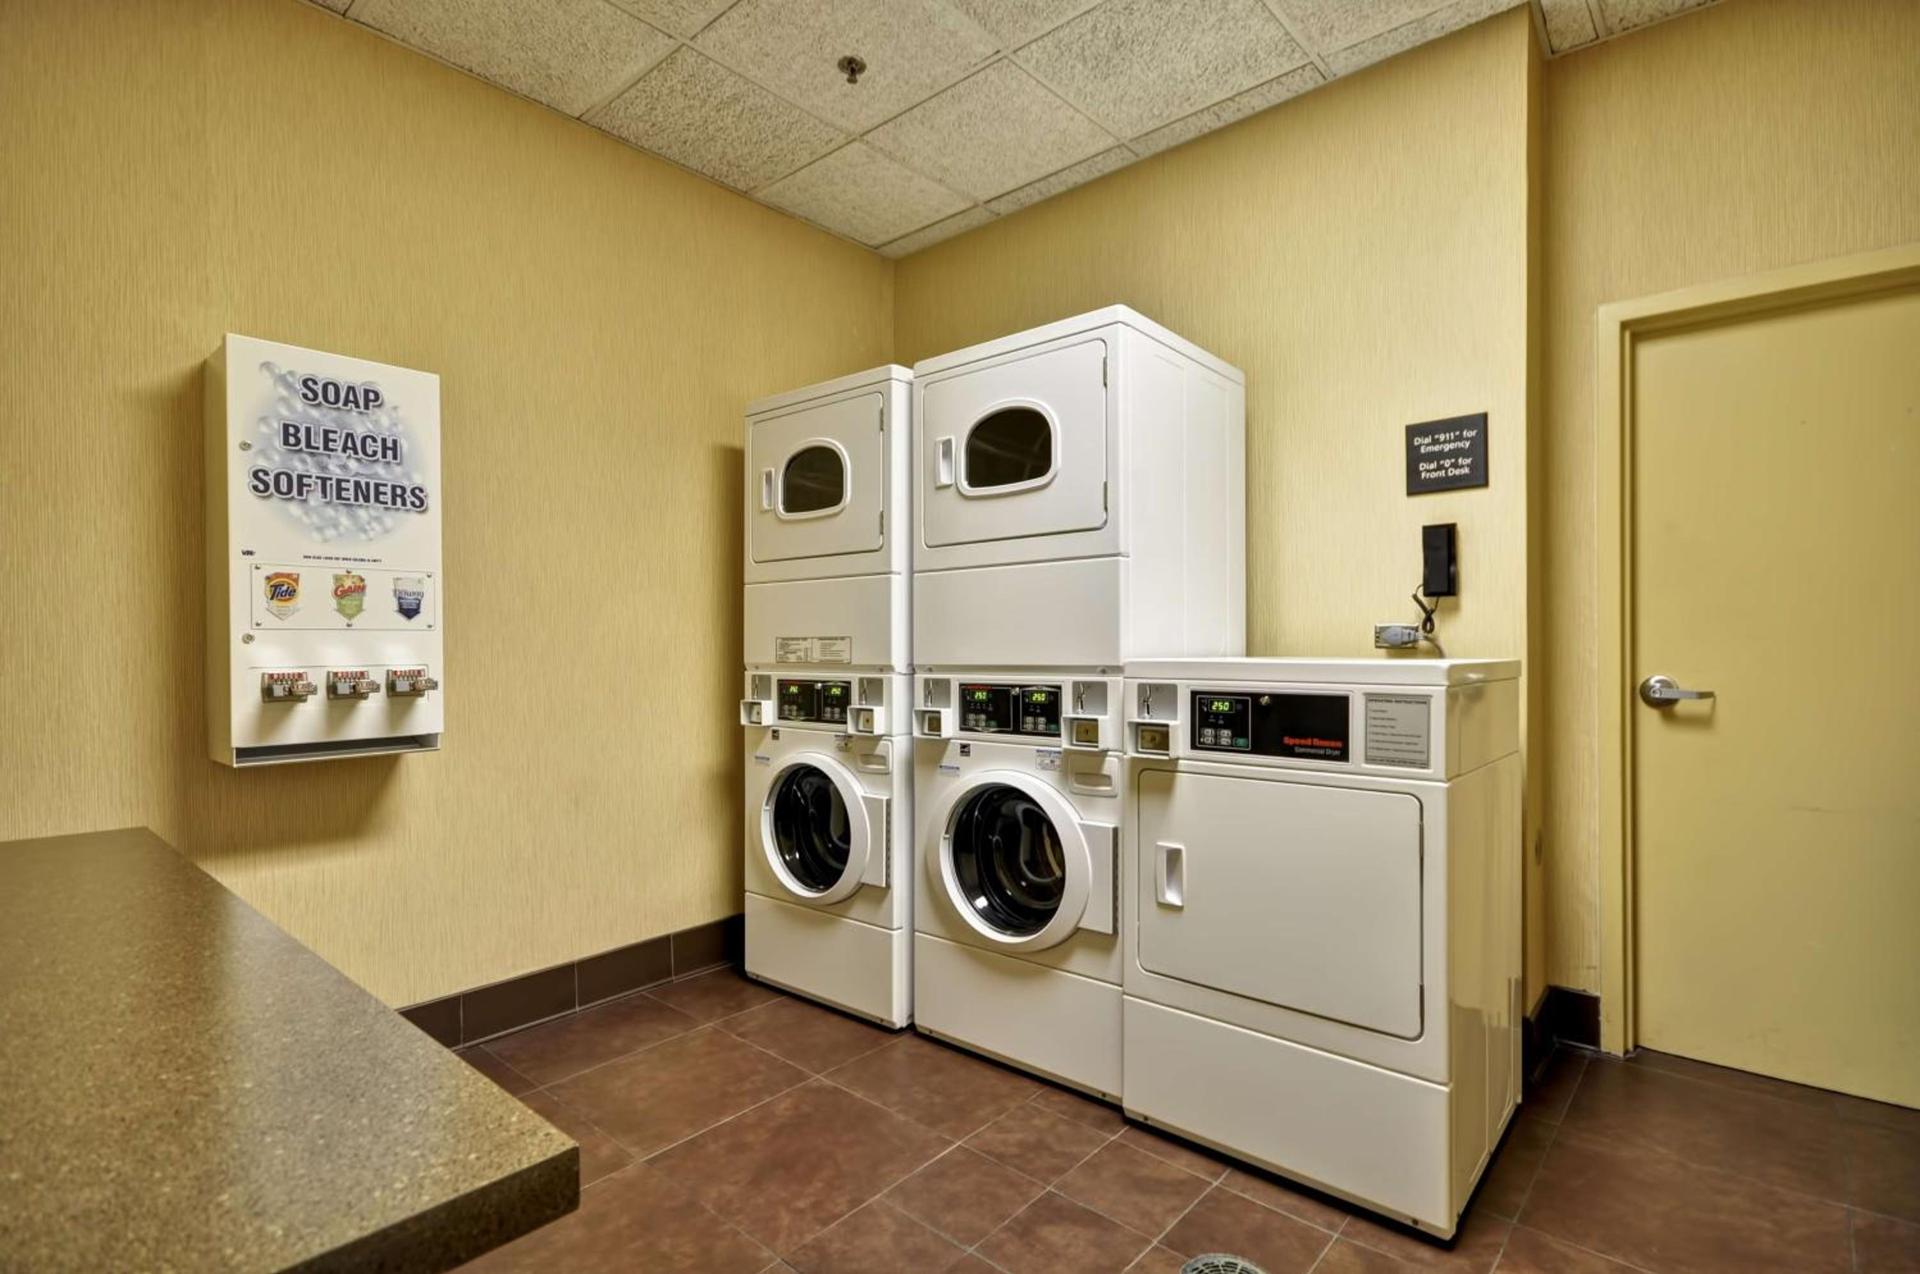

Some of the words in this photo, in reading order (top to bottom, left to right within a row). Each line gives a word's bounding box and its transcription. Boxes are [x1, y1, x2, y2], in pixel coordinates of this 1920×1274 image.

[300, 376, 382, 411] SOAP
[281, 421, 400, 462] BLEACH
[1414, 436, 1432, 446] Dial
[1463, 429, 1477, 438] for
[1420, 440, 1471, 453] Emergency
[1419, 462, 1436, 471] Dial
[1458, 457, 1472, 465] for
[1421, 470, 1445, 480] Front
[1448, 467, 1470, 476] Desk
[250, 467, 426, 511] SOFTENERS
[269, 583, 297, 601] Tide
[1211, 701, 1230, 711] 250
[1283, 735, 1312, 746] Speed
